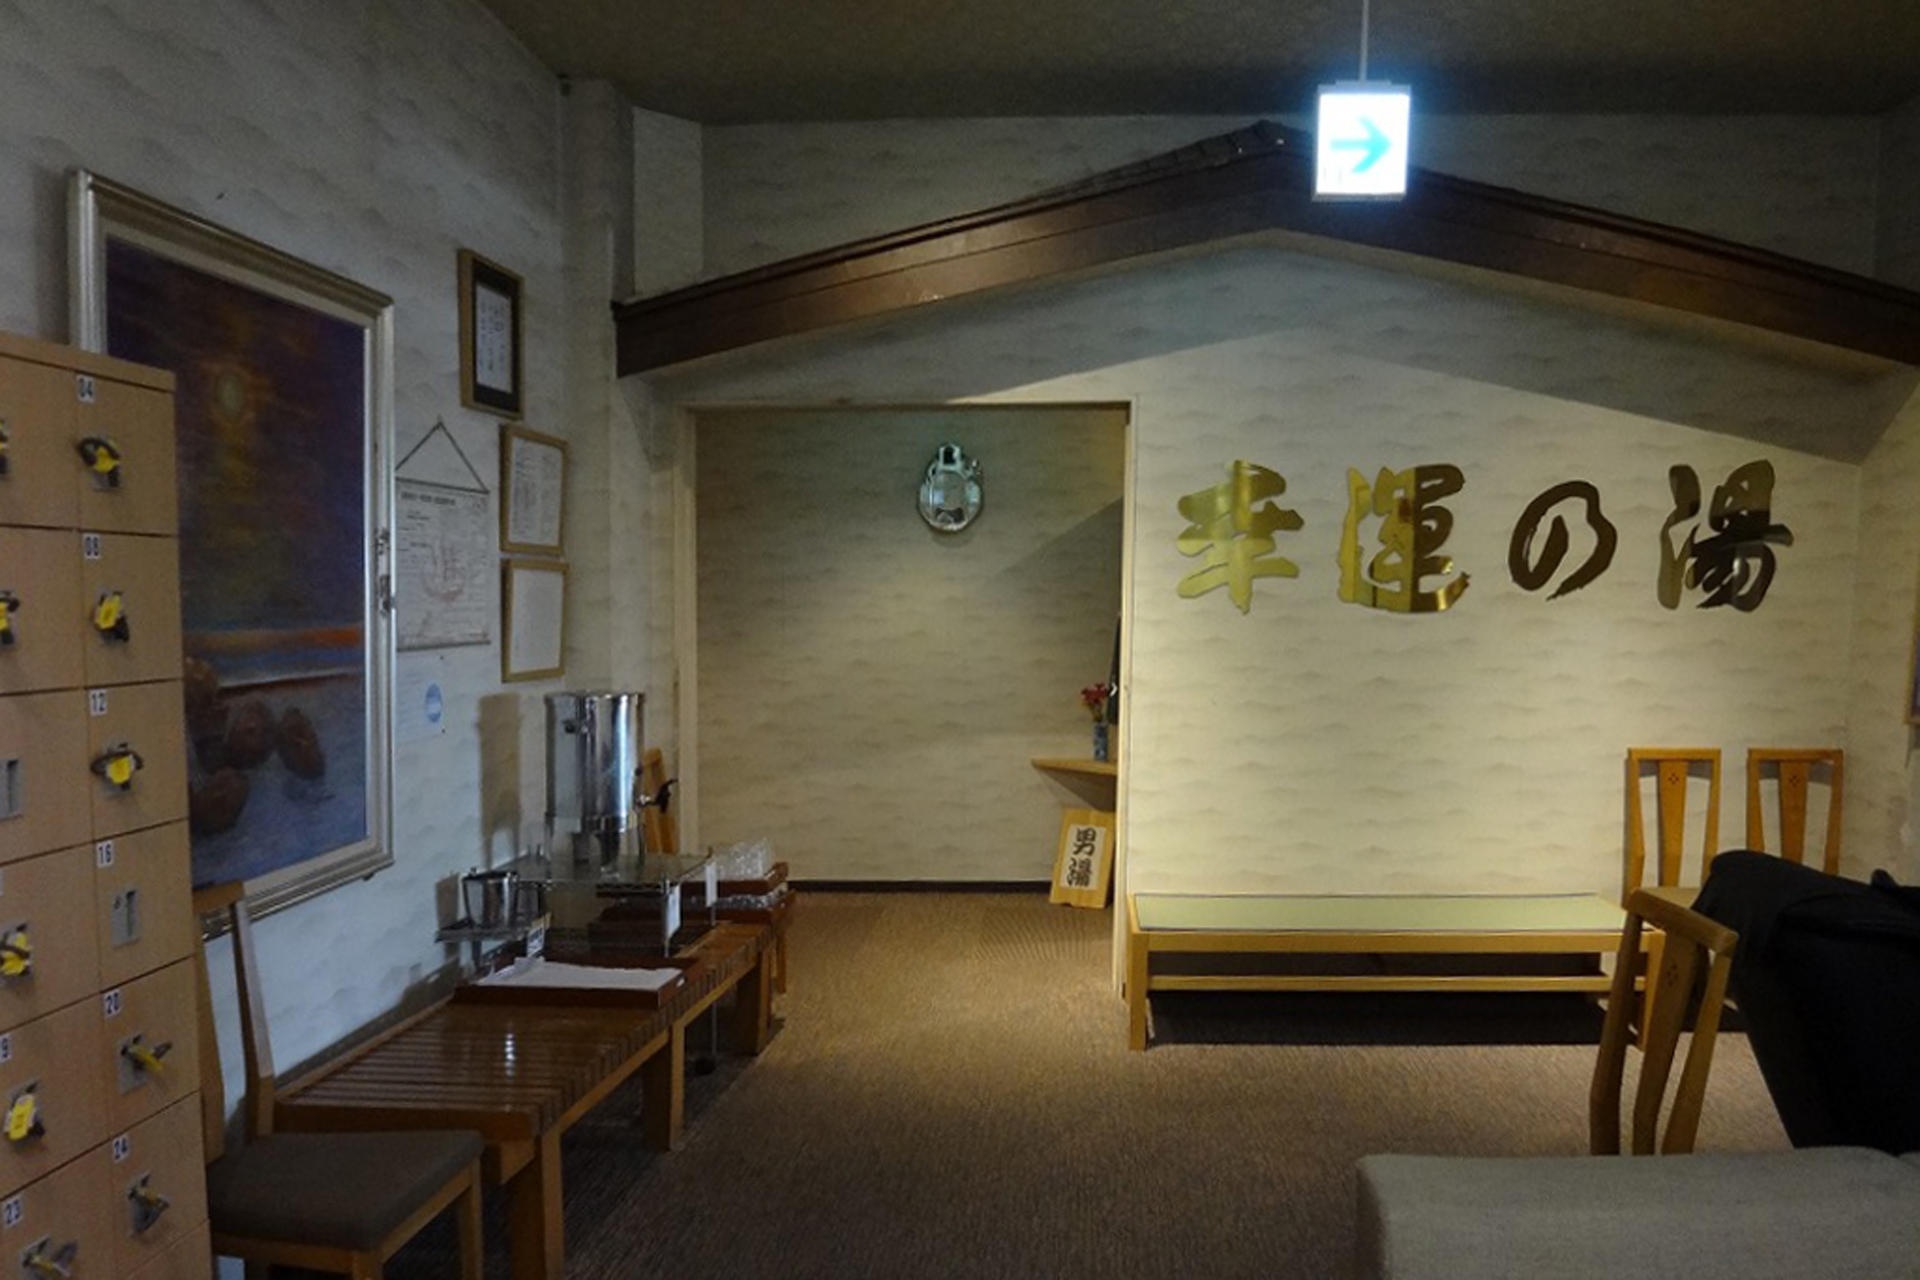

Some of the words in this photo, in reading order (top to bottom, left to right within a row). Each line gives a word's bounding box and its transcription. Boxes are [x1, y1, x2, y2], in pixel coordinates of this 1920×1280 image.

[78, 376, 93, 399] 04
[1176, 459, 1794, 614] 幸運の湯
[91, 692, 105, 713] 12
[98, 843, 111, 865] 16
[1066, 827, 1097, 887] 男湯
[113, 1137, 128, 1160] 24
